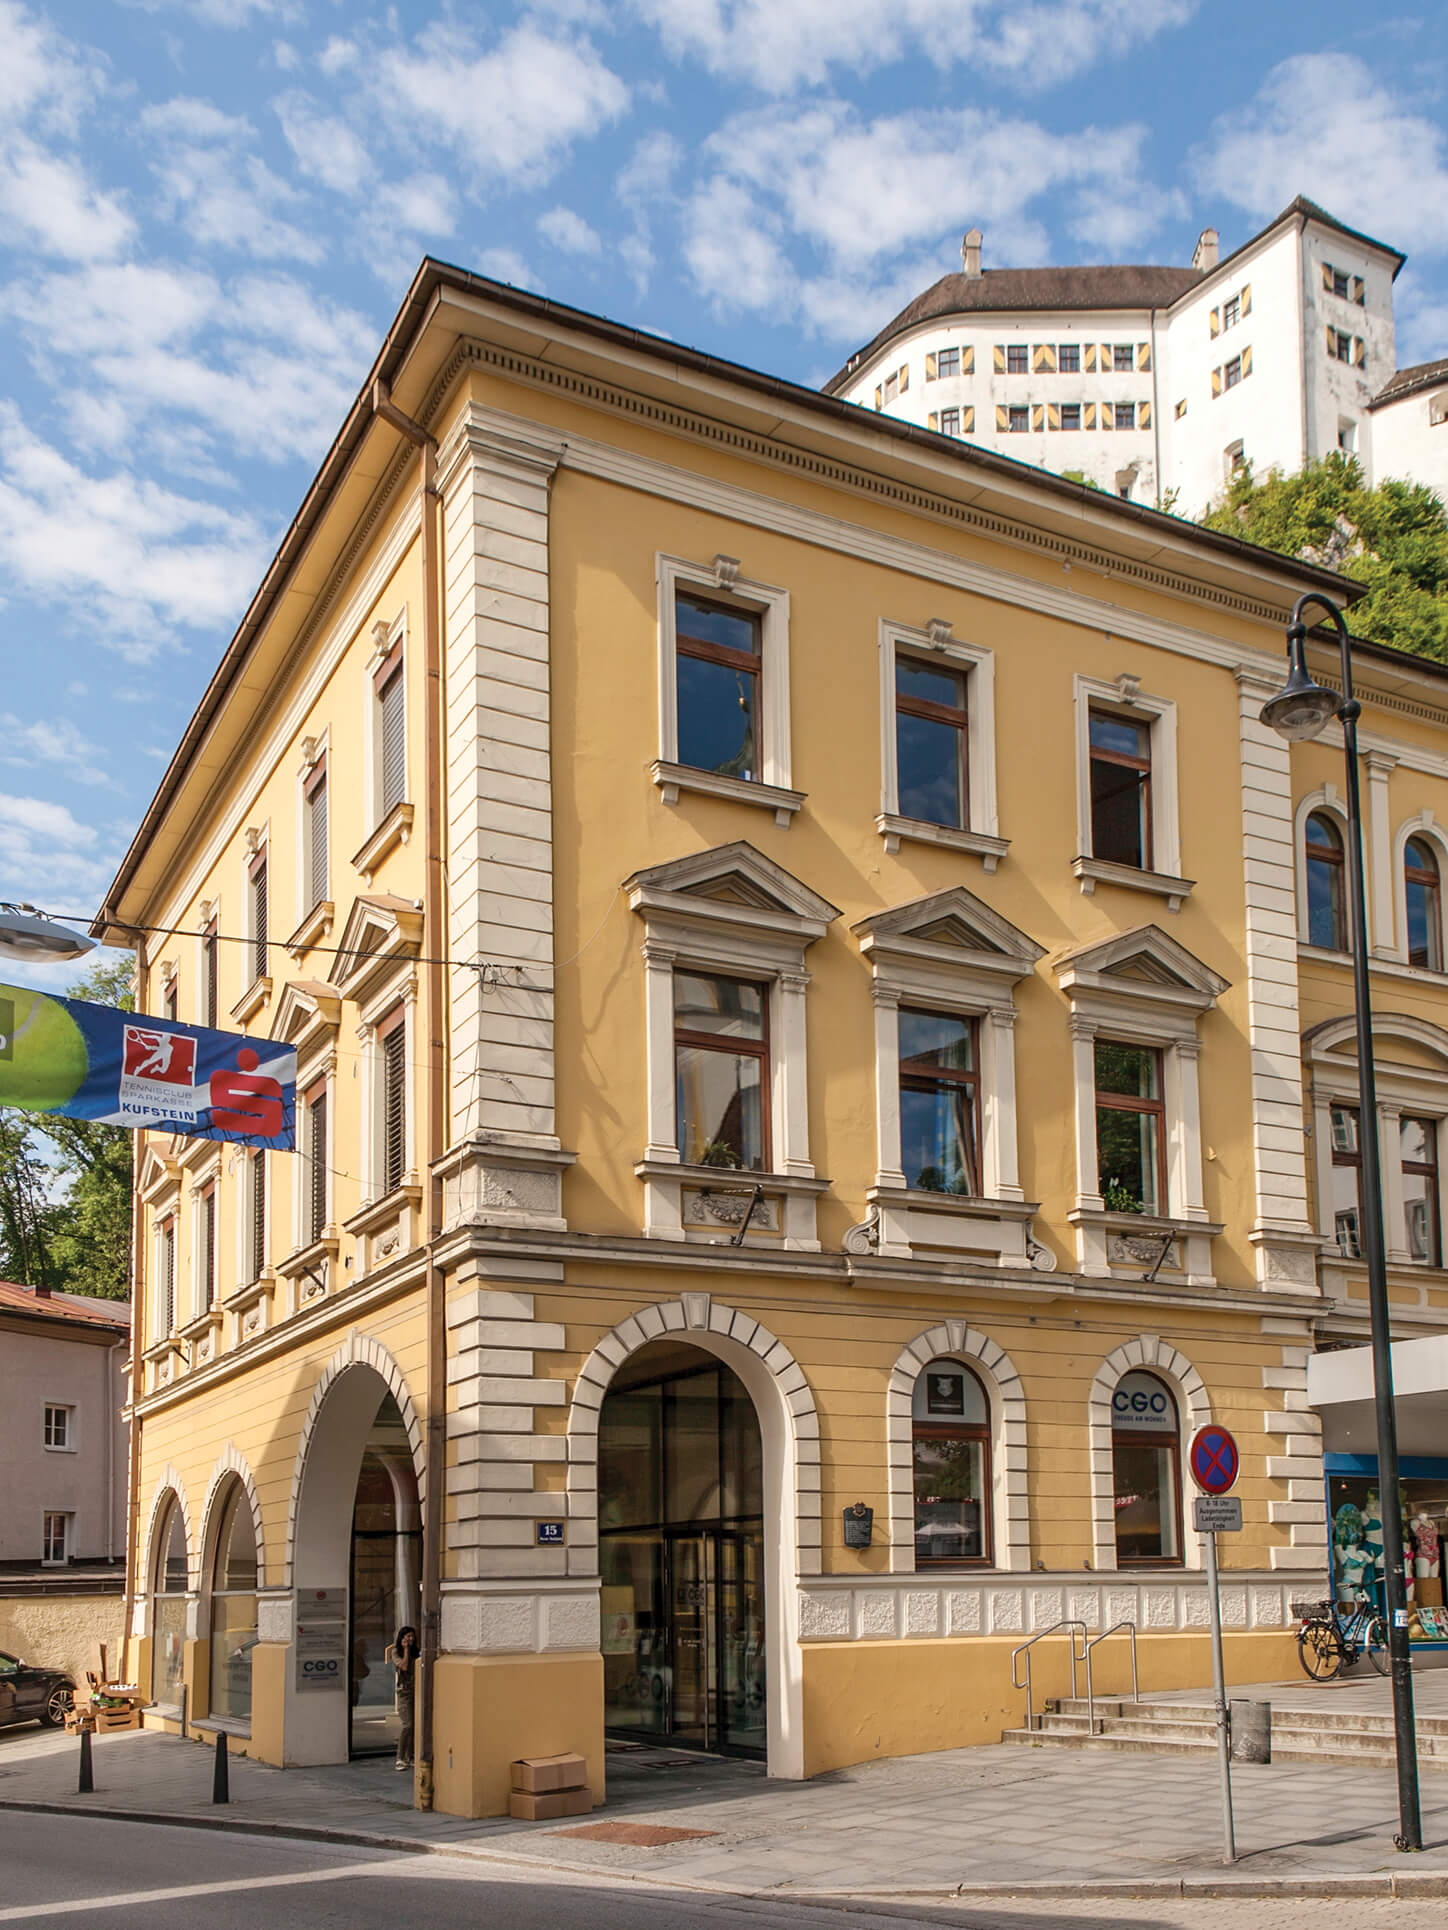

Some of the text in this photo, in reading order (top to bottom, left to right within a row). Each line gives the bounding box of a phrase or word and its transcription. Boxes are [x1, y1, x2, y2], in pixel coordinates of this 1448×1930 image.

[121, 1090, 193, 1107] SPARKASSE
[124, 1081, 193, 1099] TENNISCLUB
[122, 1102, 194, 1121] KUFSTEIN
[1112, 1391, 1167, 1413] CGO
[544, 1525, 557, 1536] 15
[303, 1660, 338, 1672] CGO
